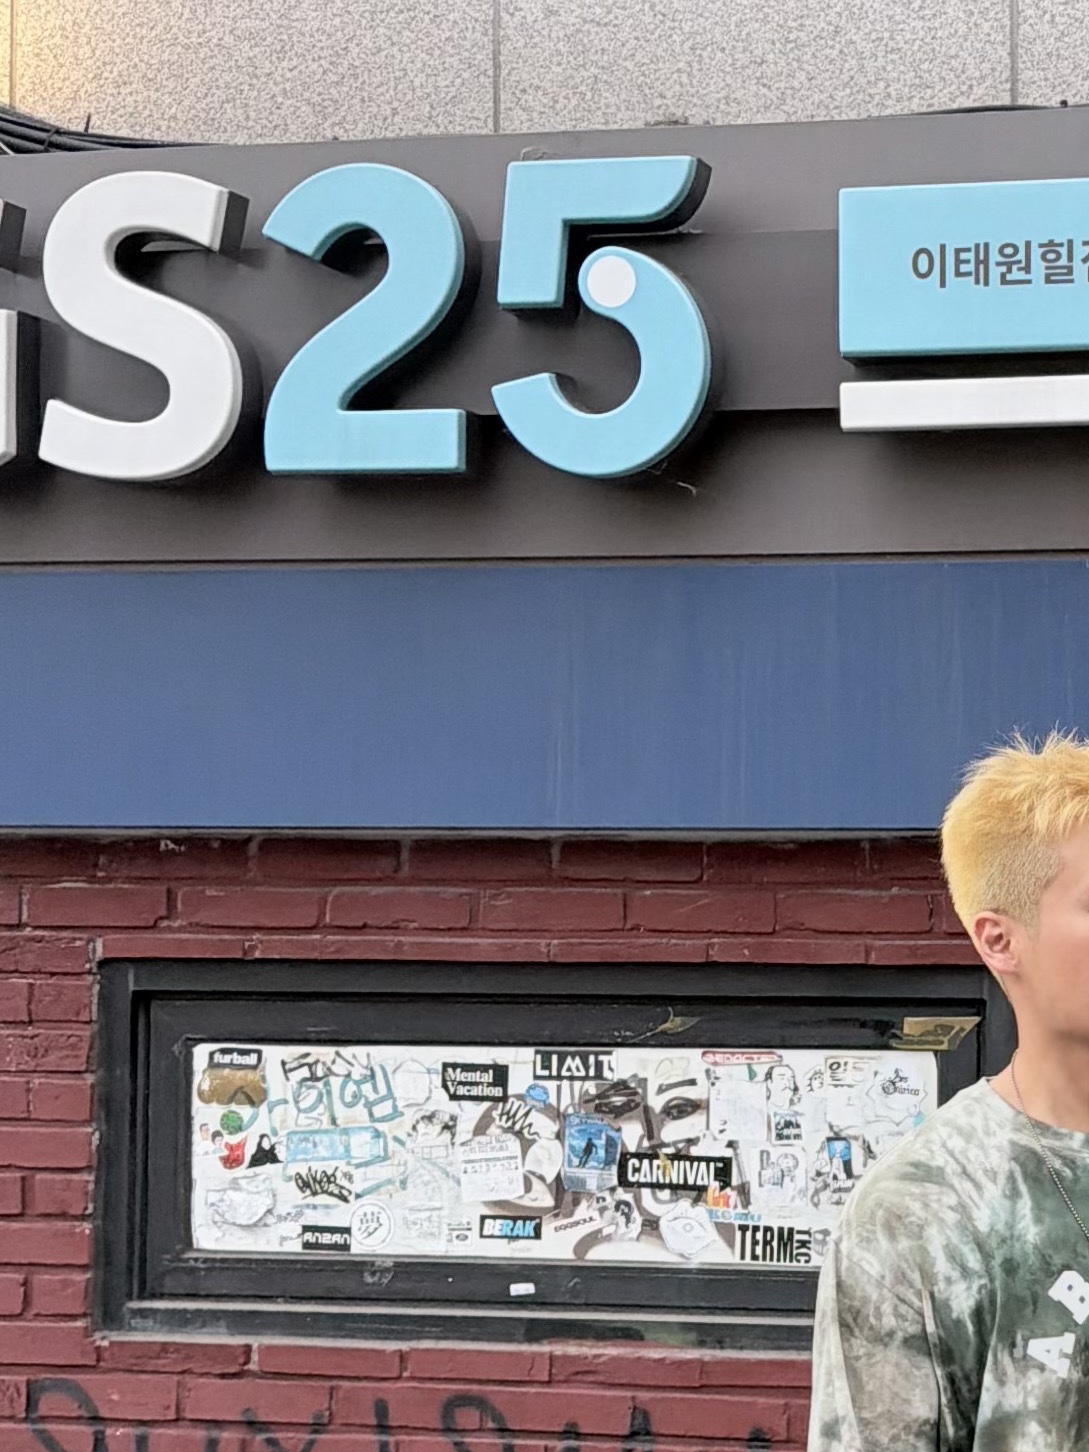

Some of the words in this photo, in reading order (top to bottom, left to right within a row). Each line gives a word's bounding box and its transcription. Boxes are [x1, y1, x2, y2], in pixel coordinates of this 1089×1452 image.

[0, 156, 712, 480] S25
[213, 1051, 259, 1066] furball
[535, 1053, 616, 1079] LIMIT
[445, 1068, 494, 1083] Mental
[447, 1082, 503, 1098] Vacation
[627, 1158, 719, 1186] CARNIVAL
[482, 1219, 537, 1237] BERAK
[738, 1224, 795, 1264] TERM
